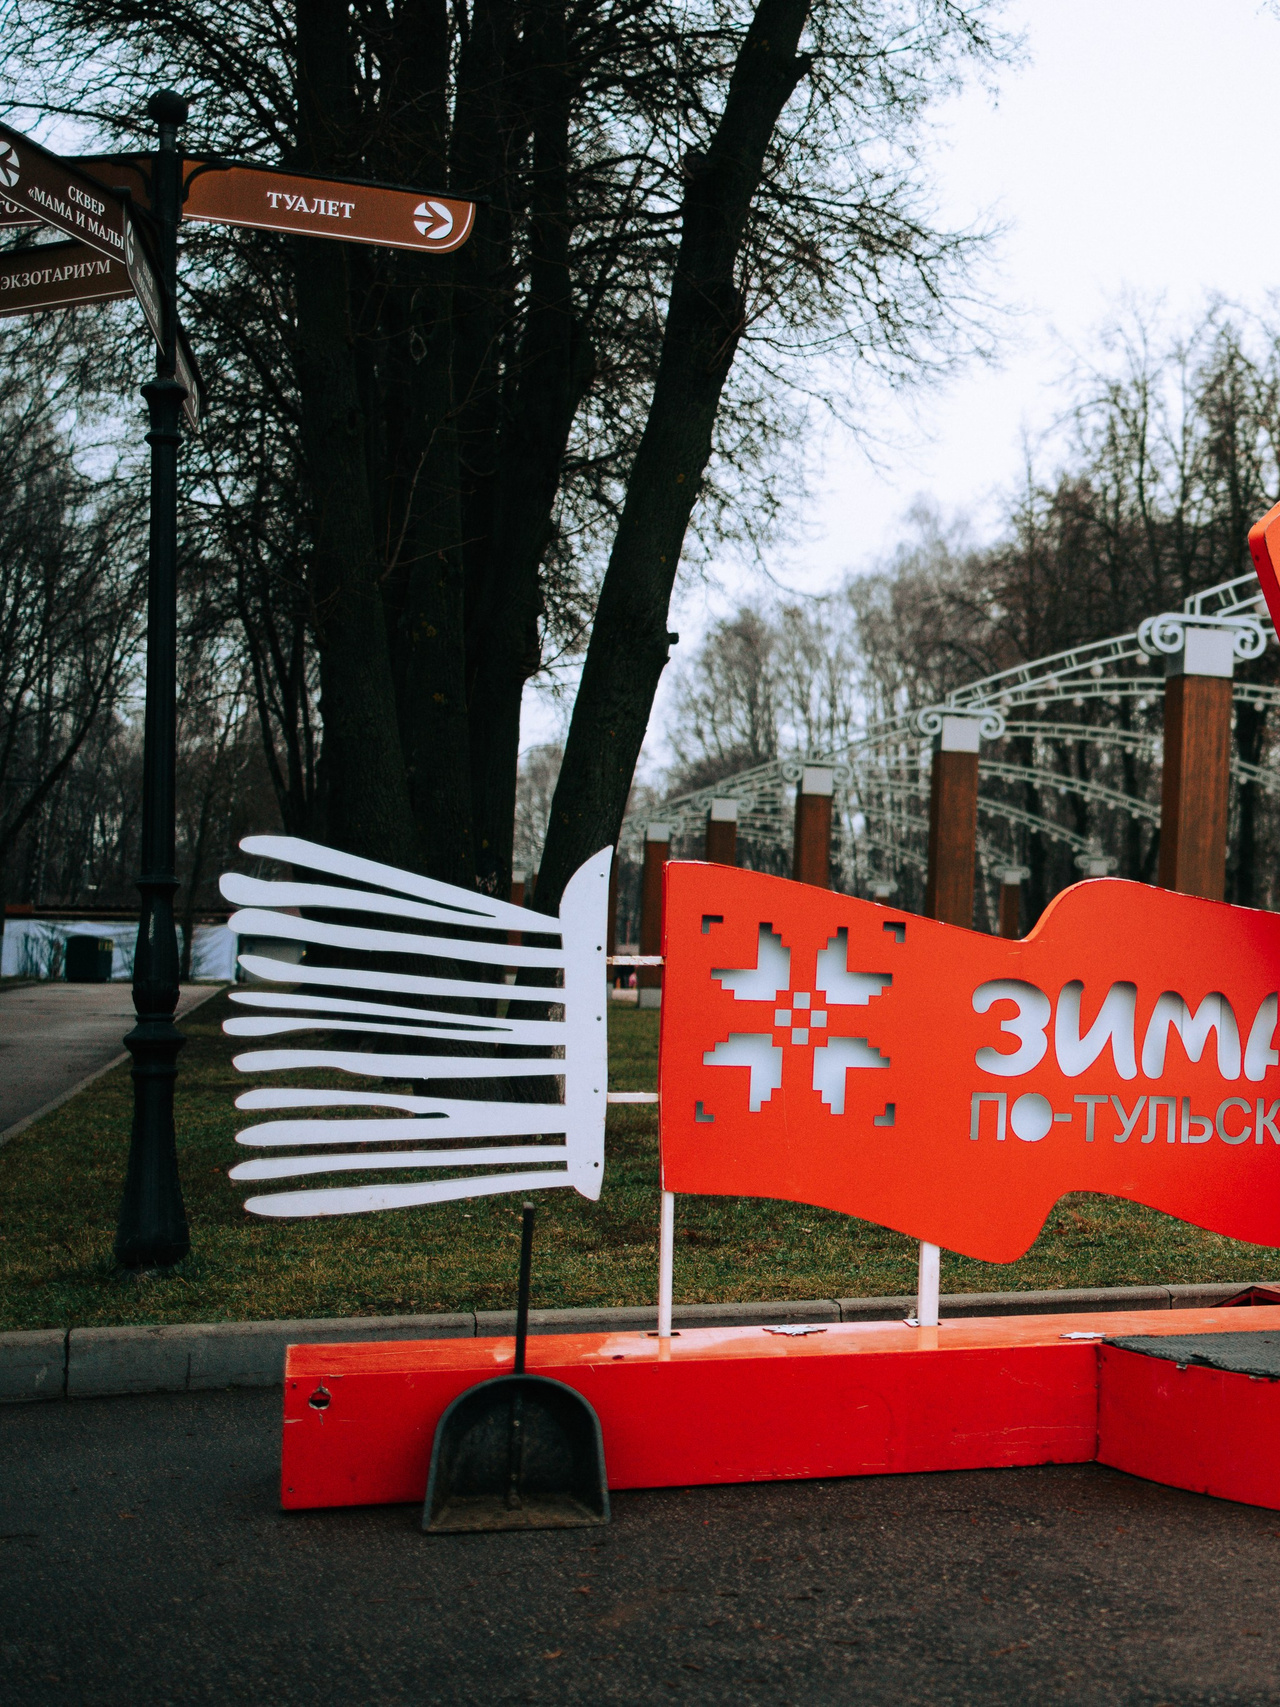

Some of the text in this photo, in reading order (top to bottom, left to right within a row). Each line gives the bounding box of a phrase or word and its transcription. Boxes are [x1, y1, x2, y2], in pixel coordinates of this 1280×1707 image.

[28, 186, 74, 222] «МАМА
[76, 210, 86, 229] И
[68, 185, 106, 217] СКВЕР
[266, 191, 356, 219] ТУАЛЕТ
[0, 259, 112, 291] ЭКЗОТАРИУМ
